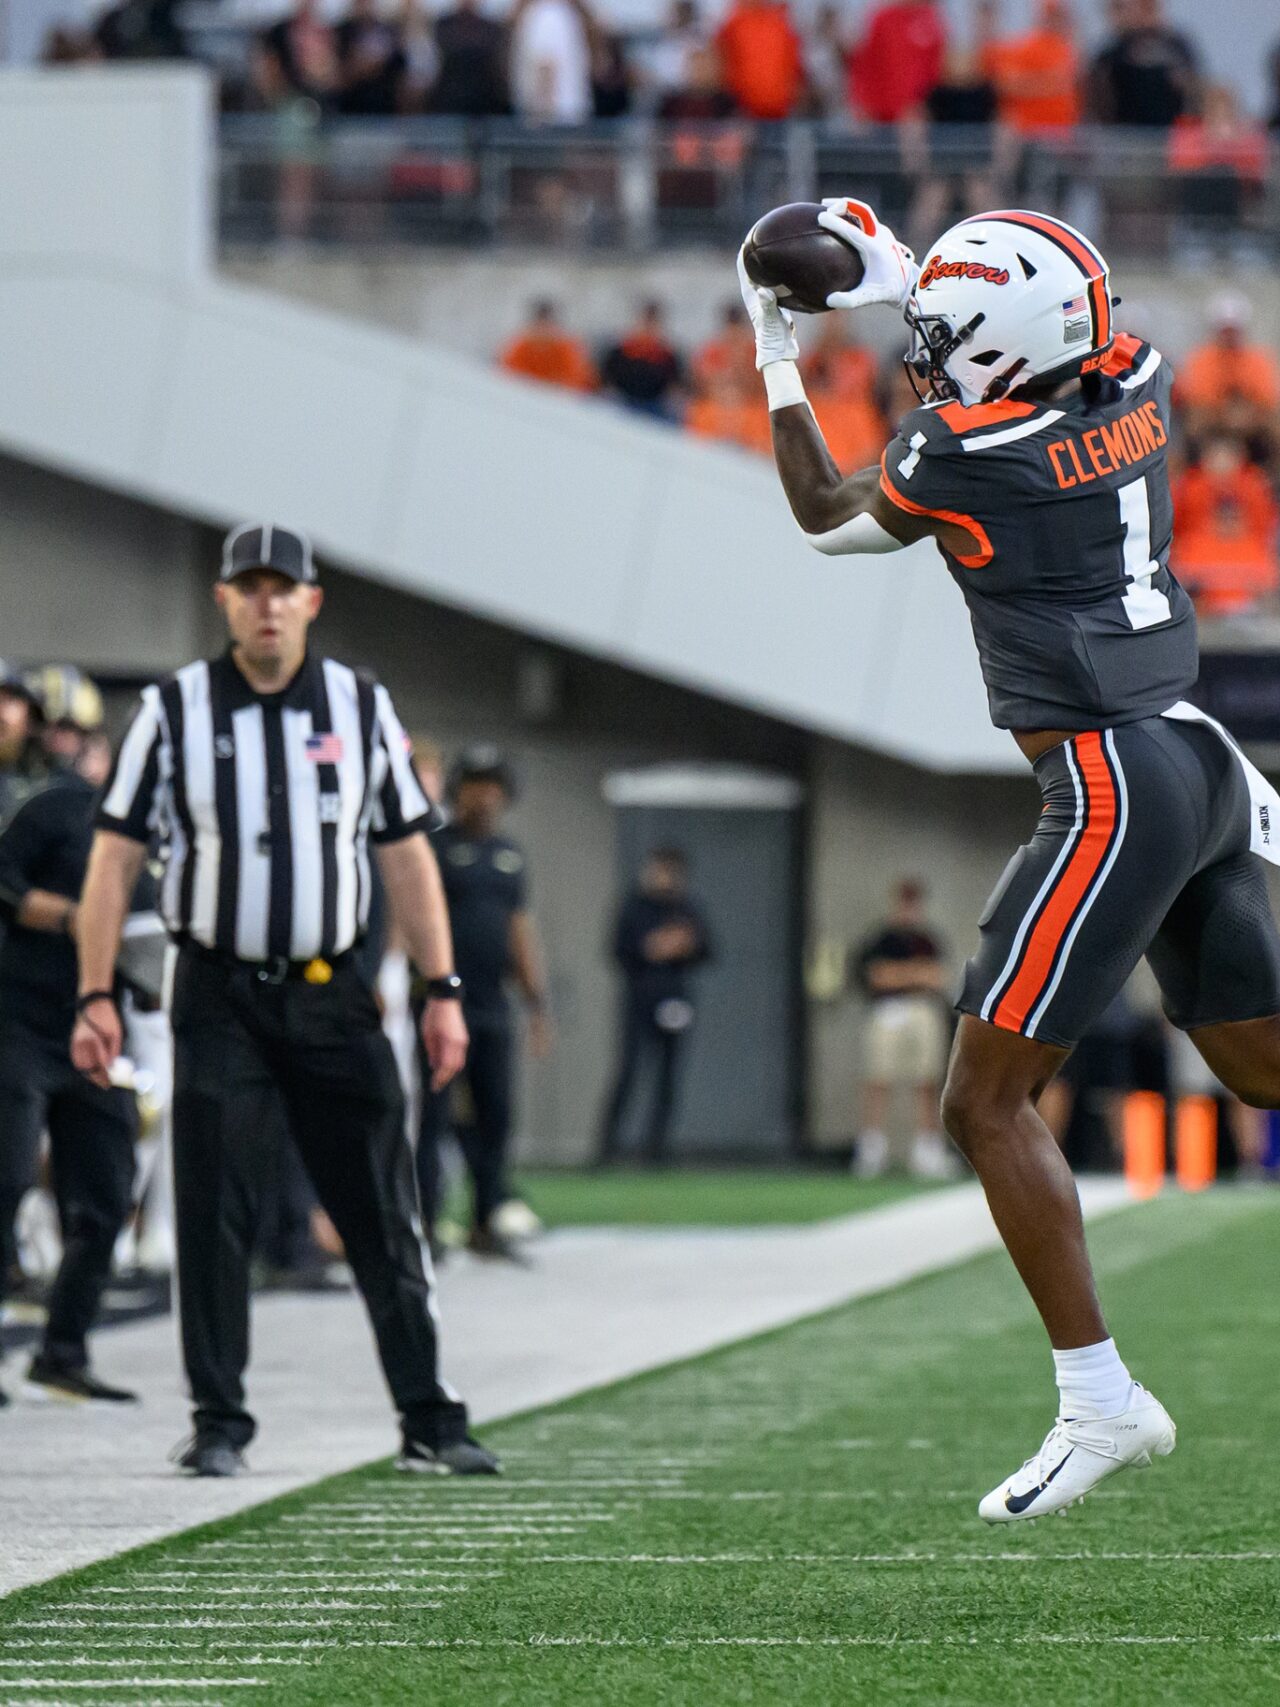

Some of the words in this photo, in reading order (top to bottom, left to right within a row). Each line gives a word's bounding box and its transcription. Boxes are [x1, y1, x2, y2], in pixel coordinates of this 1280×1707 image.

[919, 255, 1010, 290] Beavers
[897, 430, 928, 480] 1
[1047, 400, 1168, 490] CLEMONS
[1117, 475, 1172, 631] 1
